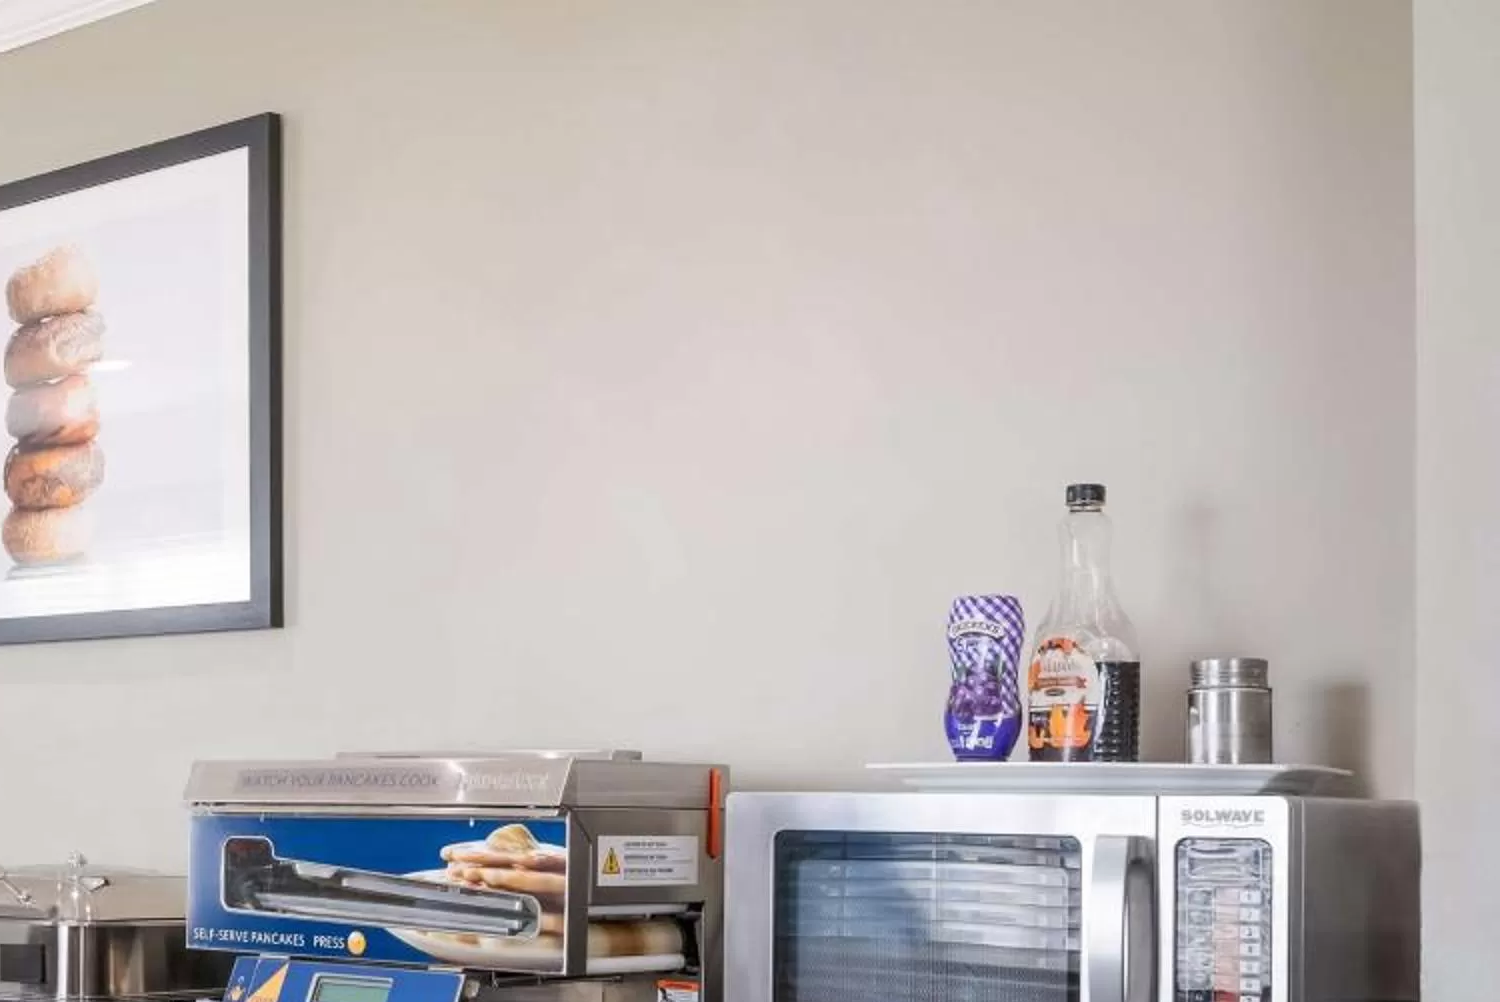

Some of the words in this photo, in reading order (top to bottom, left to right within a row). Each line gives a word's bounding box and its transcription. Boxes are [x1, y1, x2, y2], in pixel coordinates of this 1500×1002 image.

[328, 773, 397, 787] PANCAKES
[1181, 808, 1265, 823] SOLWAVE
[193, 927, 249, 943] SELF-SERVE
[251, 931, 305, 947] PANCAKES
[313, 935, 345, 950] PRESS
